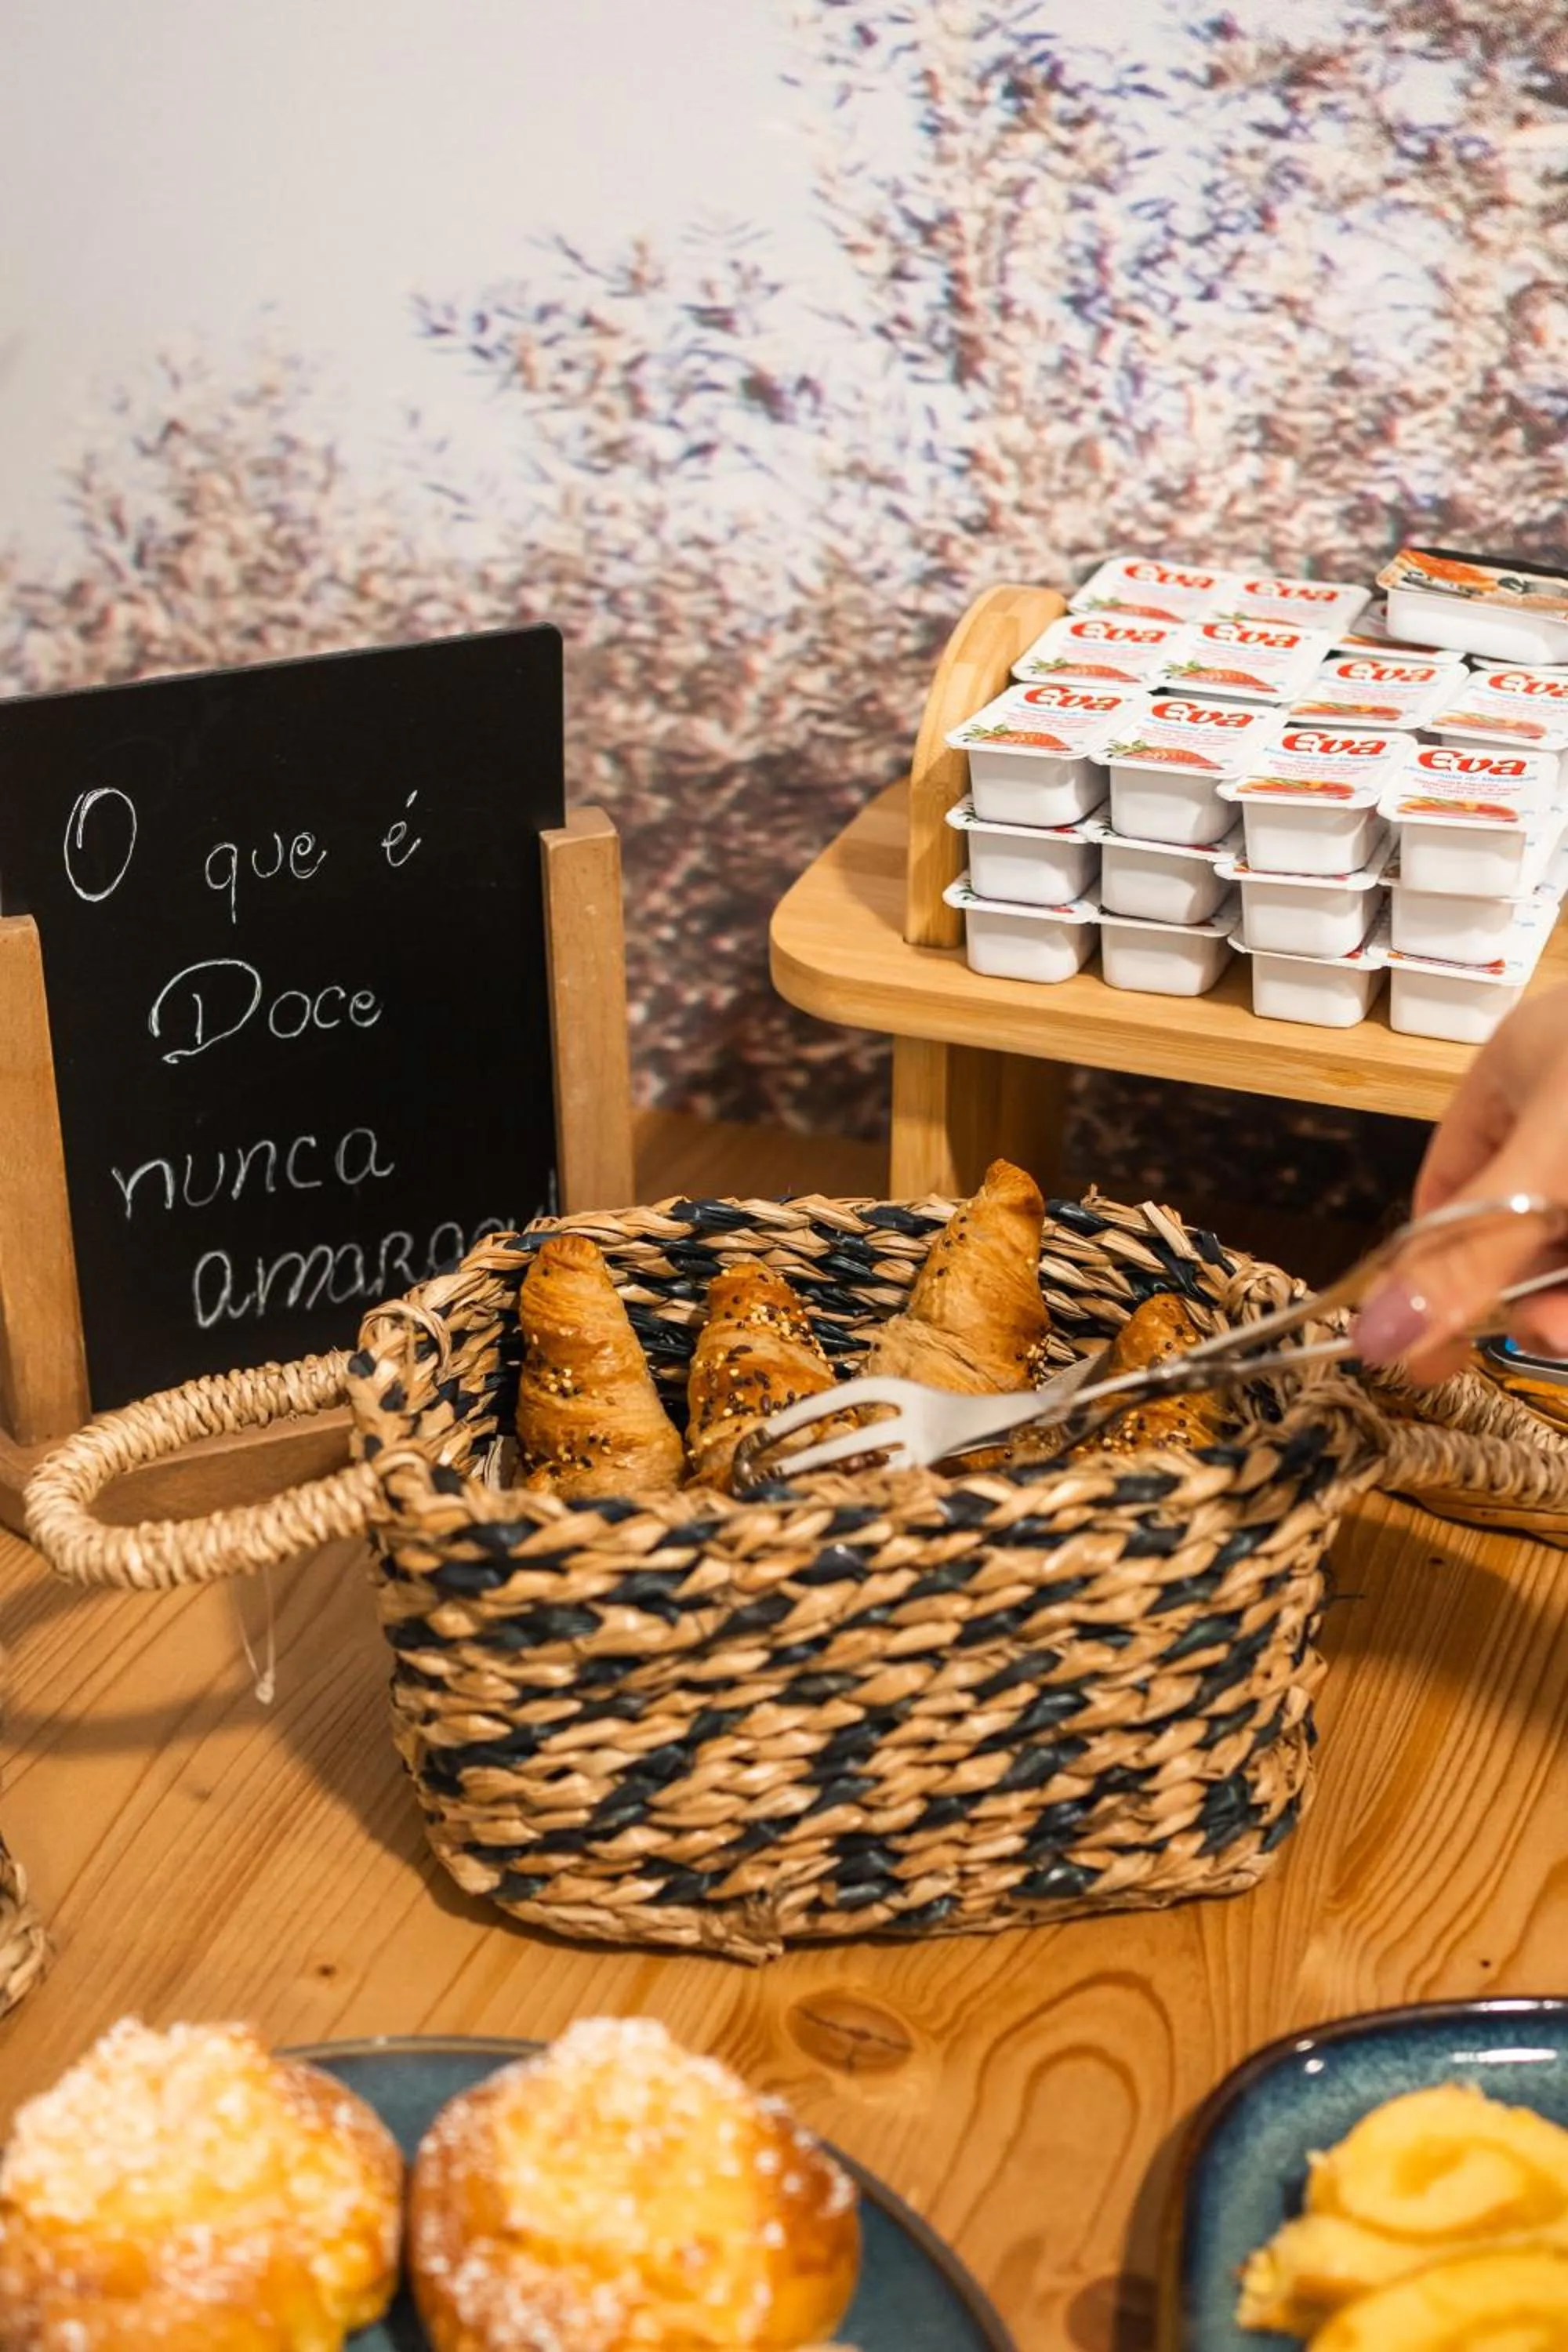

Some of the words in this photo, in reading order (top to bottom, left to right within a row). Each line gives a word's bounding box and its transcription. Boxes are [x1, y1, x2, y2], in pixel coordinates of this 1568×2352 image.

[1123, 562, 1215, 590] Eva
[1243, 580, 1339, 603] Eva
[1069, 620, 1168, 644] Eva
[1202, 623, 1301, 648] Eva
[1336, 659, 1436, 683] Eva
[1023, 685, 1123, 711] Eva
[1151, 701, 1254, 728] Eva
[1282, 731, 1387, 757] Eva
[1417, 750, 1527, 776] Eva
[64, 786, 138, 903] O
[205, 831, 328, 924] que
[381, 789, 422, 867] é
[148, 957, 382, 1065] Doce
[111, 1127, 395, 1221] nunca
